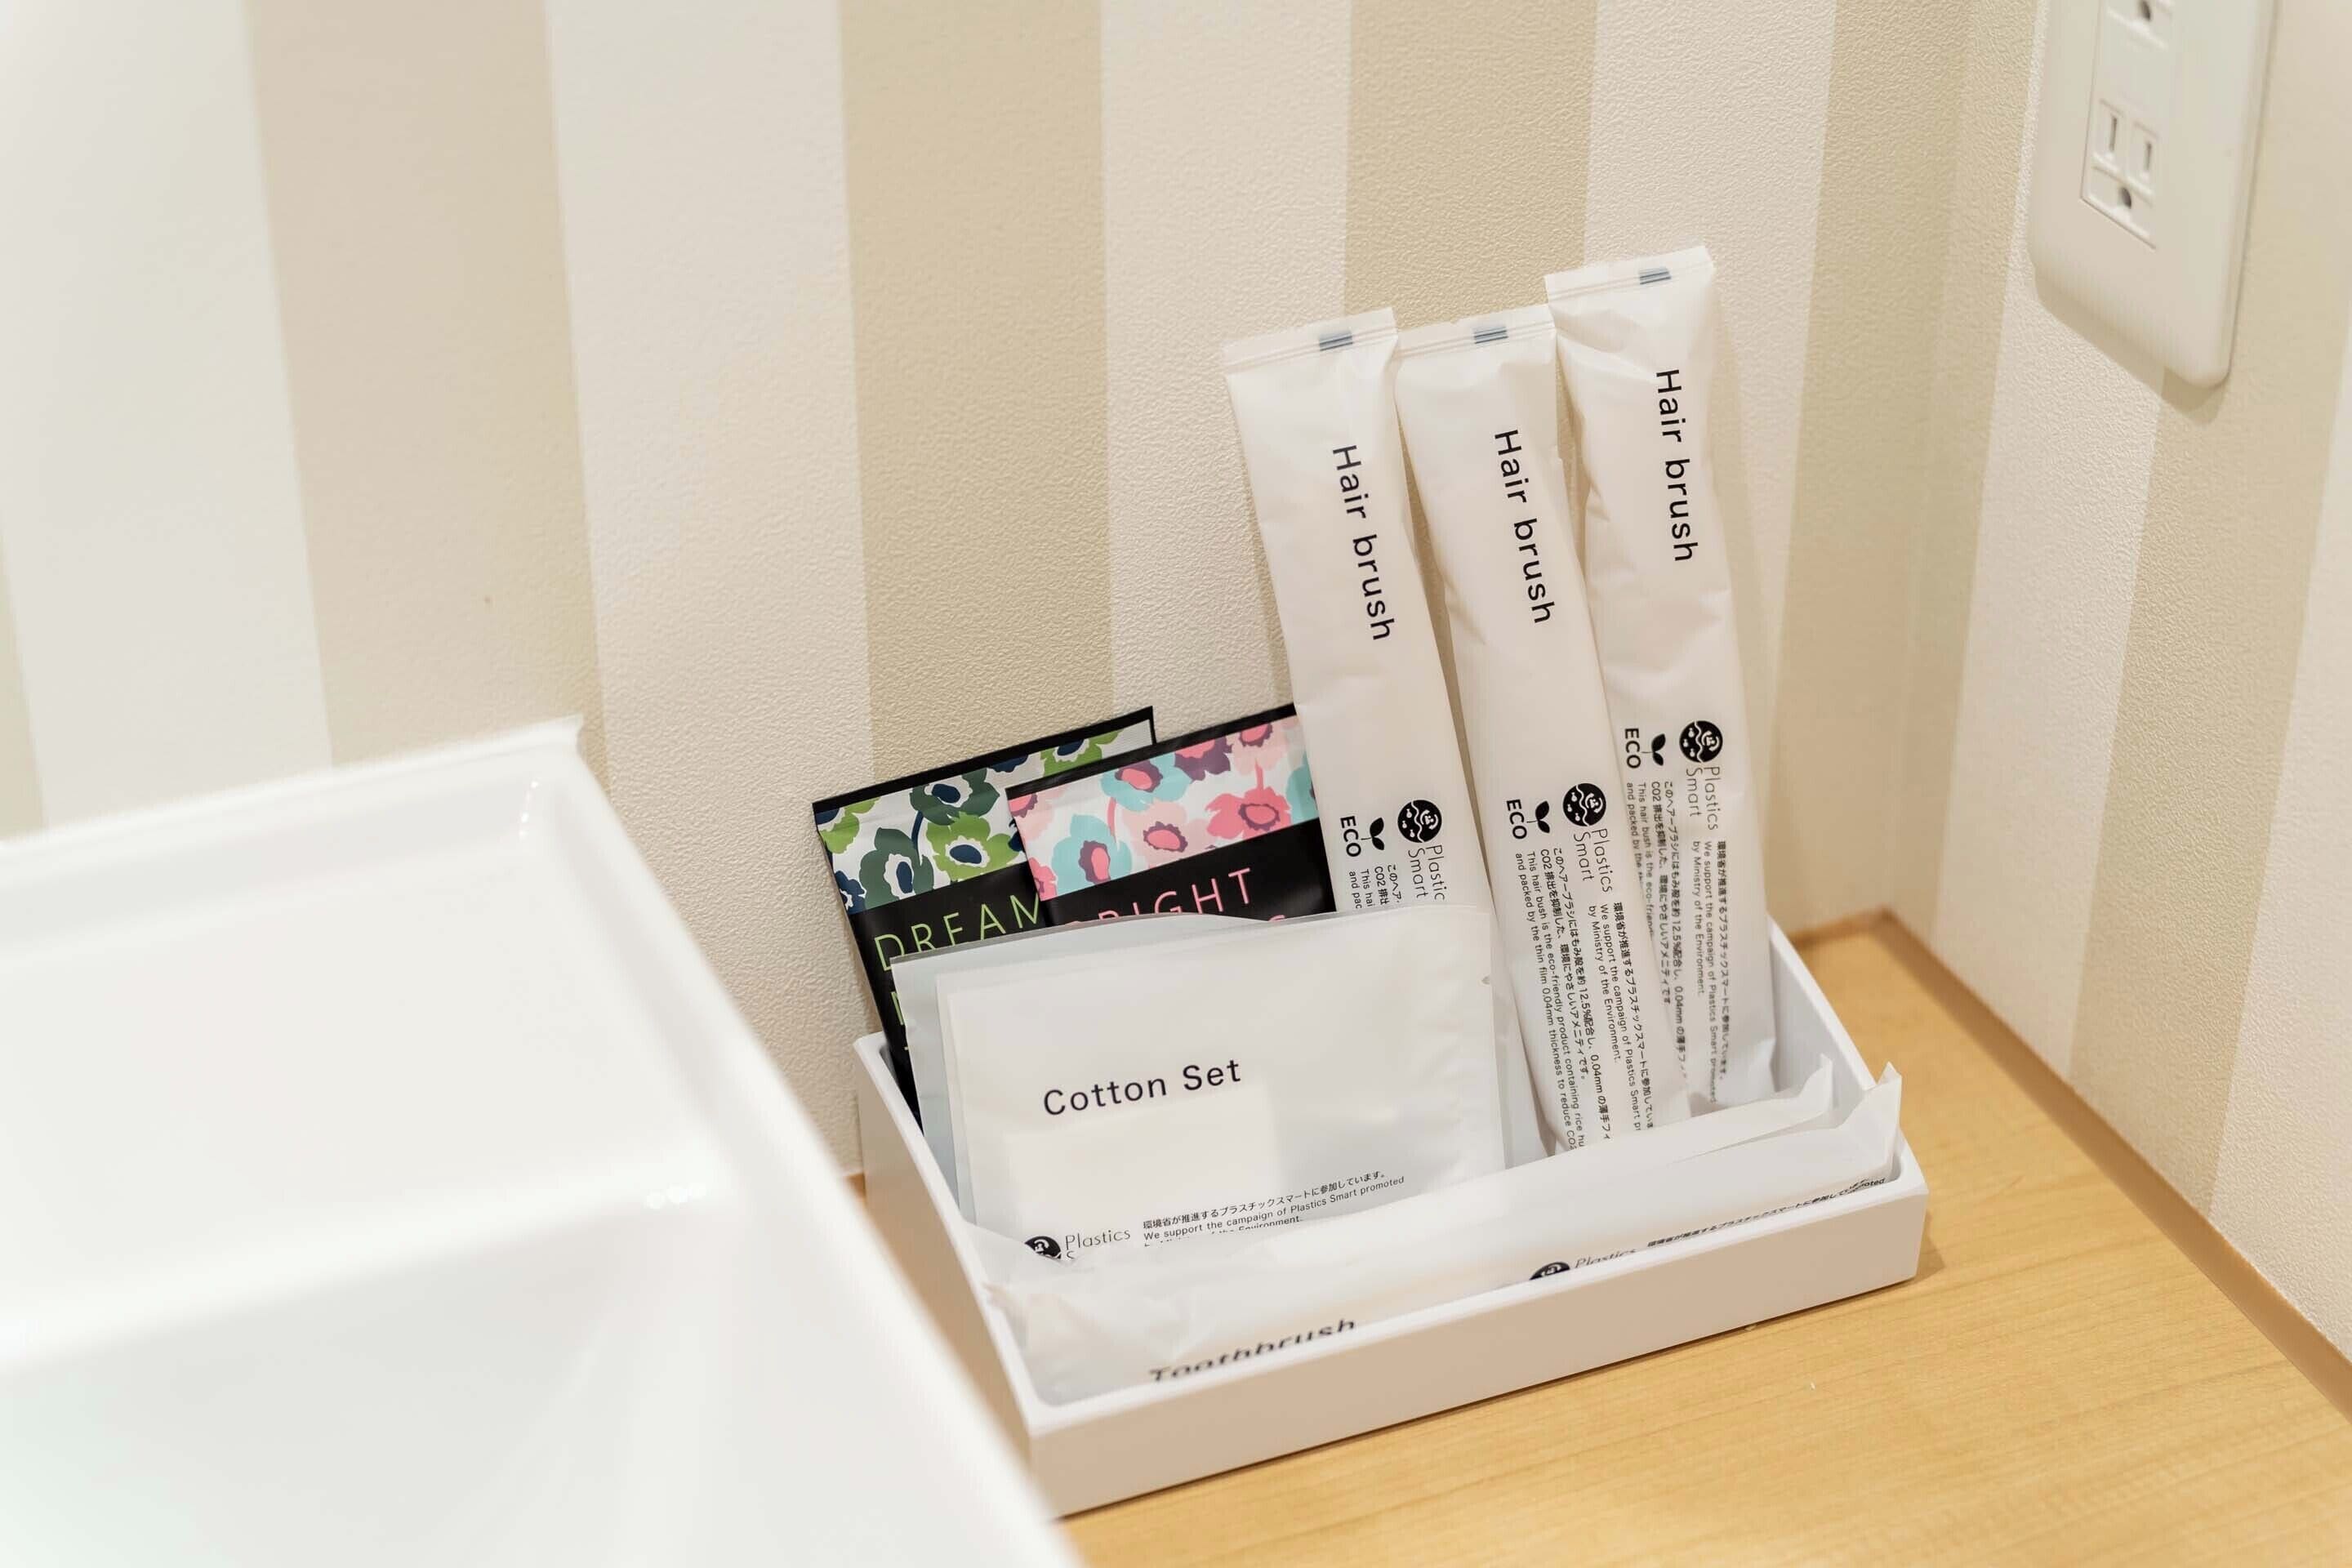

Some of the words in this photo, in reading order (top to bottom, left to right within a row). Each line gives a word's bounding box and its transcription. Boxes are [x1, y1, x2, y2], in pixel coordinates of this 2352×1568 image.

[1656, 369, 1685, 443] Hair
[1665, 459, 1698, 561] brush
[1333, 445, 1369, 519] Hair
[1352, 534, 1395, 640] brush
[1494, 430, 1529, 503] Hair
[1513, 518, 1555, 623] brush
[1624, 728, 1642, 769] ECO
[1627, 782, 1636, 800] and
[1686, 768, 1703, 817] Smart
[1704, 766, 1721, 830] Plastics
[1506, 799, 1527, 840] ECO
[1627, 804, 1640, 836] packed
[1638, 782, 1646, 802] This
[1642, 826, 1651, 848] bush
[1339, 816, 1361, 858] ECO
[1691, 841, 1699, 853] by
[1704, 841, 1712, 857] We
[1516, 853, 1526, 871] and
[1527, 851, 1538, 871] This
[1540, 849, 1552, 870] CO2
[1574, 831, 1594, 881] Smart
[1591, 828, 1613, 893] Plastics
[1349, 871, 1360, 889] and
[1361, 869, 1370, 889] This
[1374, 866, 1386, 887] CO2
[1408, 848, 1428, 898] Smart
[1531, 875, 1542, 893] hair
[1692, 857, 1701, 897] Ministry
[1704, 861, 1713, 898] support
[1518, 874, 1535, 907] packed
[1695, 901, 1703, 910] of
[1526, 911, 1535, 922] by
[1536, 896, 1548, 920] bush
[1588, 906, 1597, 917] by
[1601, 904, 1609, 920] We
[1695, 915, 1703, 929] the
[1705, 902, 1713, 918] the
[1531, 925, 1540, 941] the
[1542, 922, 1549, 930] is
[1544, 933, 1552, 949] the
[1592, 921, 1603, 961] Ministry
[1535, 944, 1544, 963] thin
[1603, 924, 1616, 963] support
[1705, 922, 1715, 967] campaign
[1539, 967, 1548, 984] film
[1548, 953, 1563, 1012] eco-friendly
[1598, 965, 1608, 975] of
[1610, 966, 1619, 982] the
[1708, 971, 1716, 980] of
[1601, 979, 1610, 995] the
[1708, 984, 1717, 1022] Plastics
[1542, 988, 1553, 1026] 0.04mm
[1614, 986, 1627, 1031] campaign
[1556, 1017, 1570, 1055] product
[1604, 999, 1621, 1062] Environment.
[1622, 1036, 1631, 1045] of
[1549, 1029, 1562, 1076] thickness
[1624, 1049, 1636, 1087] Plastics
[1044, 1078, 1166, 1116] Cotton
[1183, 1059, 1241, 1090] Set
[1557, 1079, 1565, 1089] to
[1565, 1058, 1579, 1109] containing
[1561, 1093, 1571, 1126] reduce
[1630, 1089, 1641, 1119] Smart
[1575, 1113, 1583, 1131] rice
[1143, 1232, 1160, 1241] We
[1164, 1224, 1202, 1237] support
[1207, 1222, 1223, 1230] the
[1227, 1212, 1273, 1226] campaign
[1277, 1207, 1286, 1216] of
[1290, 1199, 1326, 1214] Plastics
[1330, 1189, 1357, 1202] Smart
[1361, 1176, 1404, 1196] promoted
[1066, 1230, 1130, 1251] Plastics
[1150, 1320, 1354, 1381] Toothbrush
